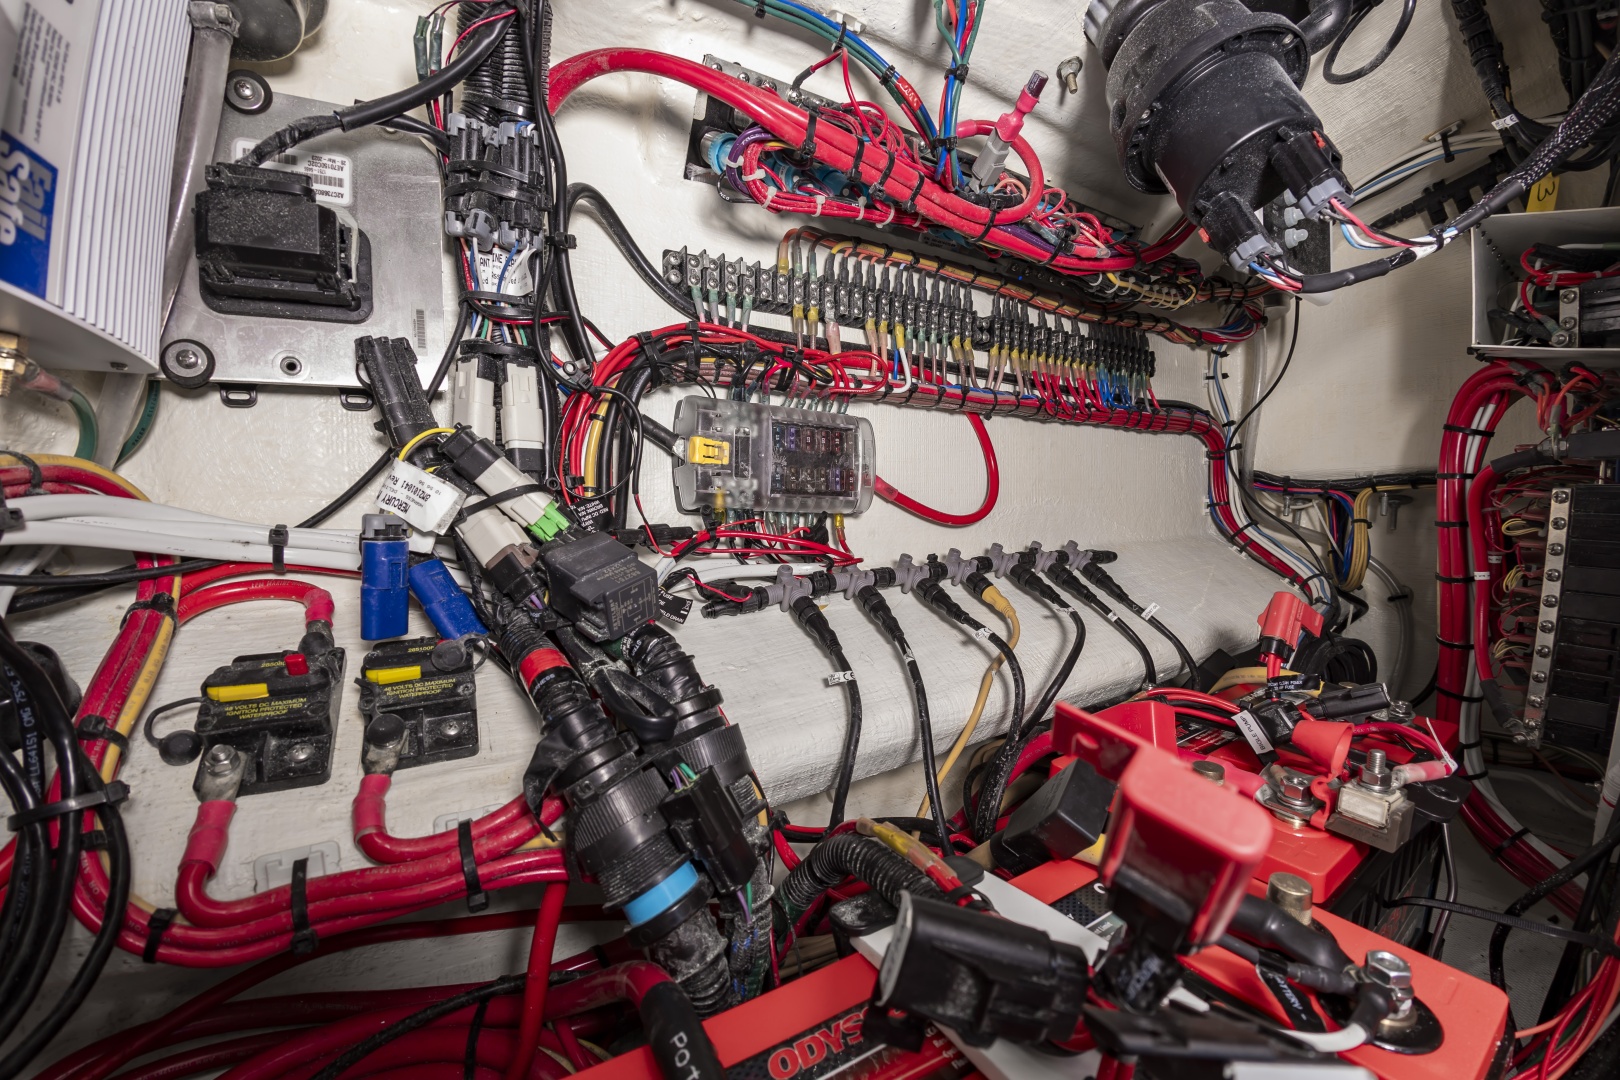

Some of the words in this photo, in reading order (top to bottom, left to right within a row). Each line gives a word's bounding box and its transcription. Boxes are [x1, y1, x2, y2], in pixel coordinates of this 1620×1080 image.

[381, 493, 411, 514] MERCURY
[386, 688, 415, 696] IGNITION
[416, 683, 454, 693] PROTECTED
[392, 683, 413, 691] VOLTS
[424, 678, 456, 687] MAXIMUM
[398, 688, 442, 699] WATERPROOF
[226, 708, 258, 717] IGNITION
[260, 702, 303, 713] PROTECTED
[234, 703, 258, 711] VOLTS
[270, 697, 307, 707] MAXIMUM
[238, 709, 288, 719] WATERPROOF
[768, 1006, 869, 1080] ODYS
